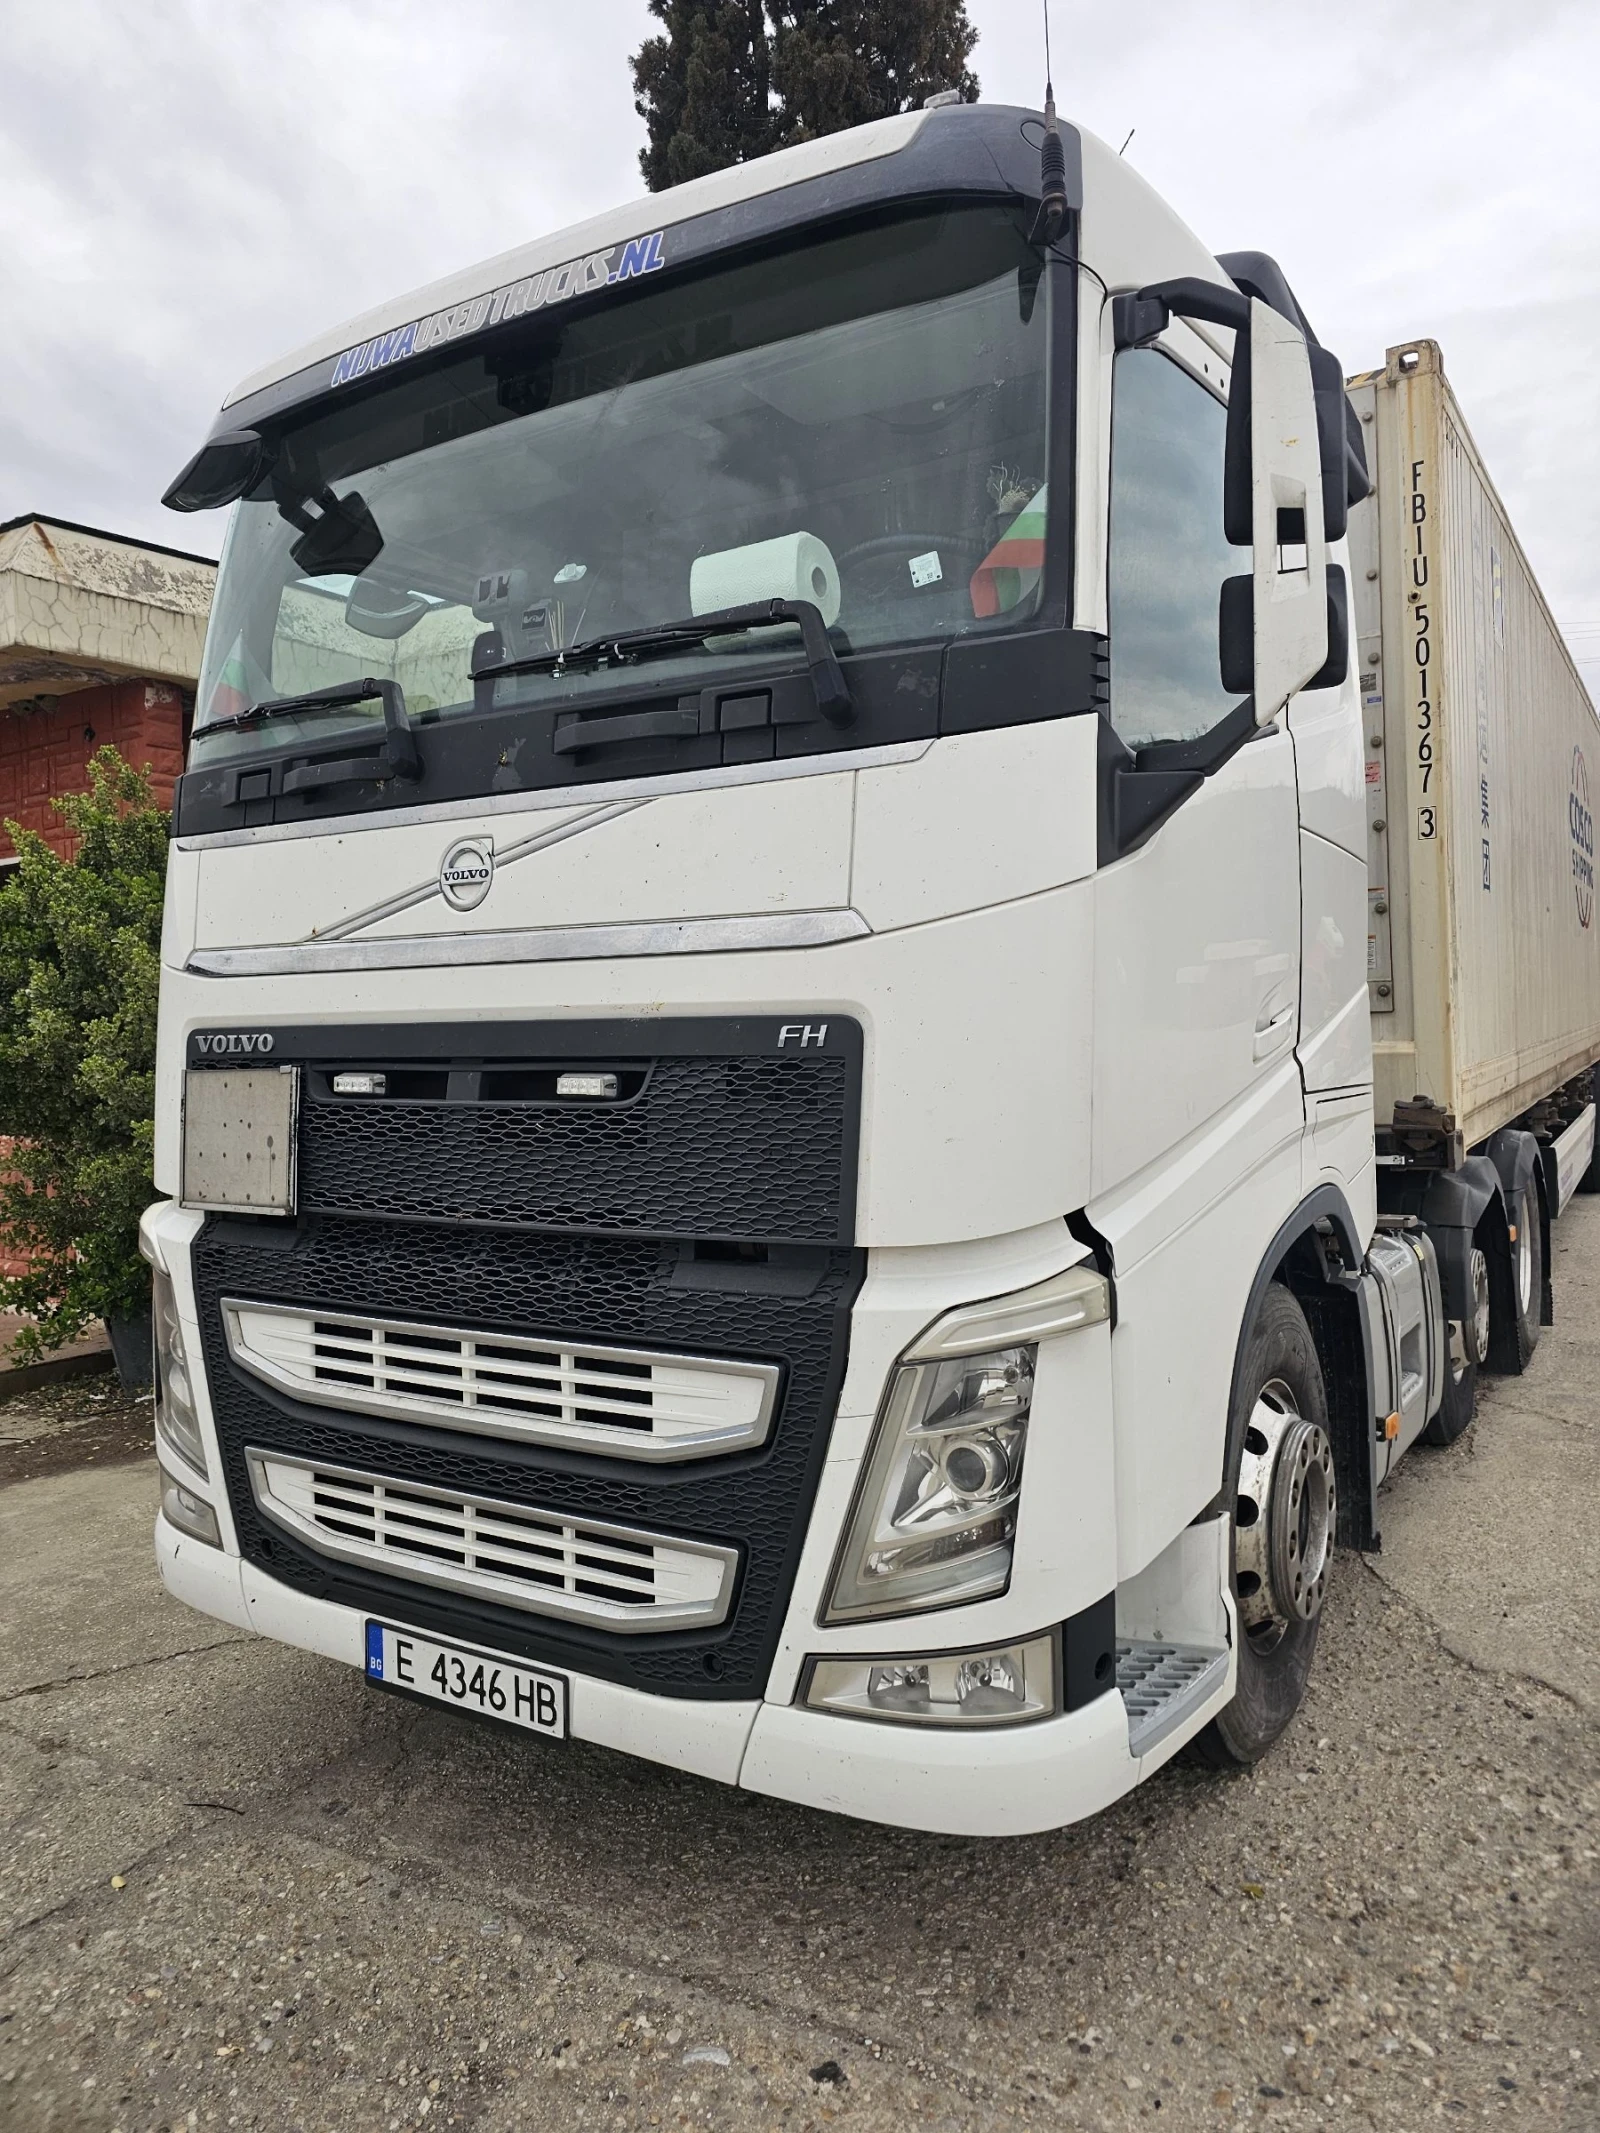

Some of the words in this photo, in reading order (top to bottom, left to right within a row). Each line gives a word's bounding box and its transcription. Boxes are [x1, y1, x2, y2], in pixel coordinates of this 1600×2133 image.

[1412, 460, 1428, 587] FBIU
[1415, 604, 1433, 794] 501367
[1420, 809, 1435, 838] 3
[1570, 792, 1593, 858] COSCO
[443, 868, 490, 882] VOLVO
[195, 1033, 274, 1054] VOLVO
[777, 1024, 828, 1047] FH
[370, 1656, 382, 1671] BG
[396, 1639, 415, 1684] E
[431, 1653, 507, 1712] 4346
[514, 1675, 558, 1728] HB
